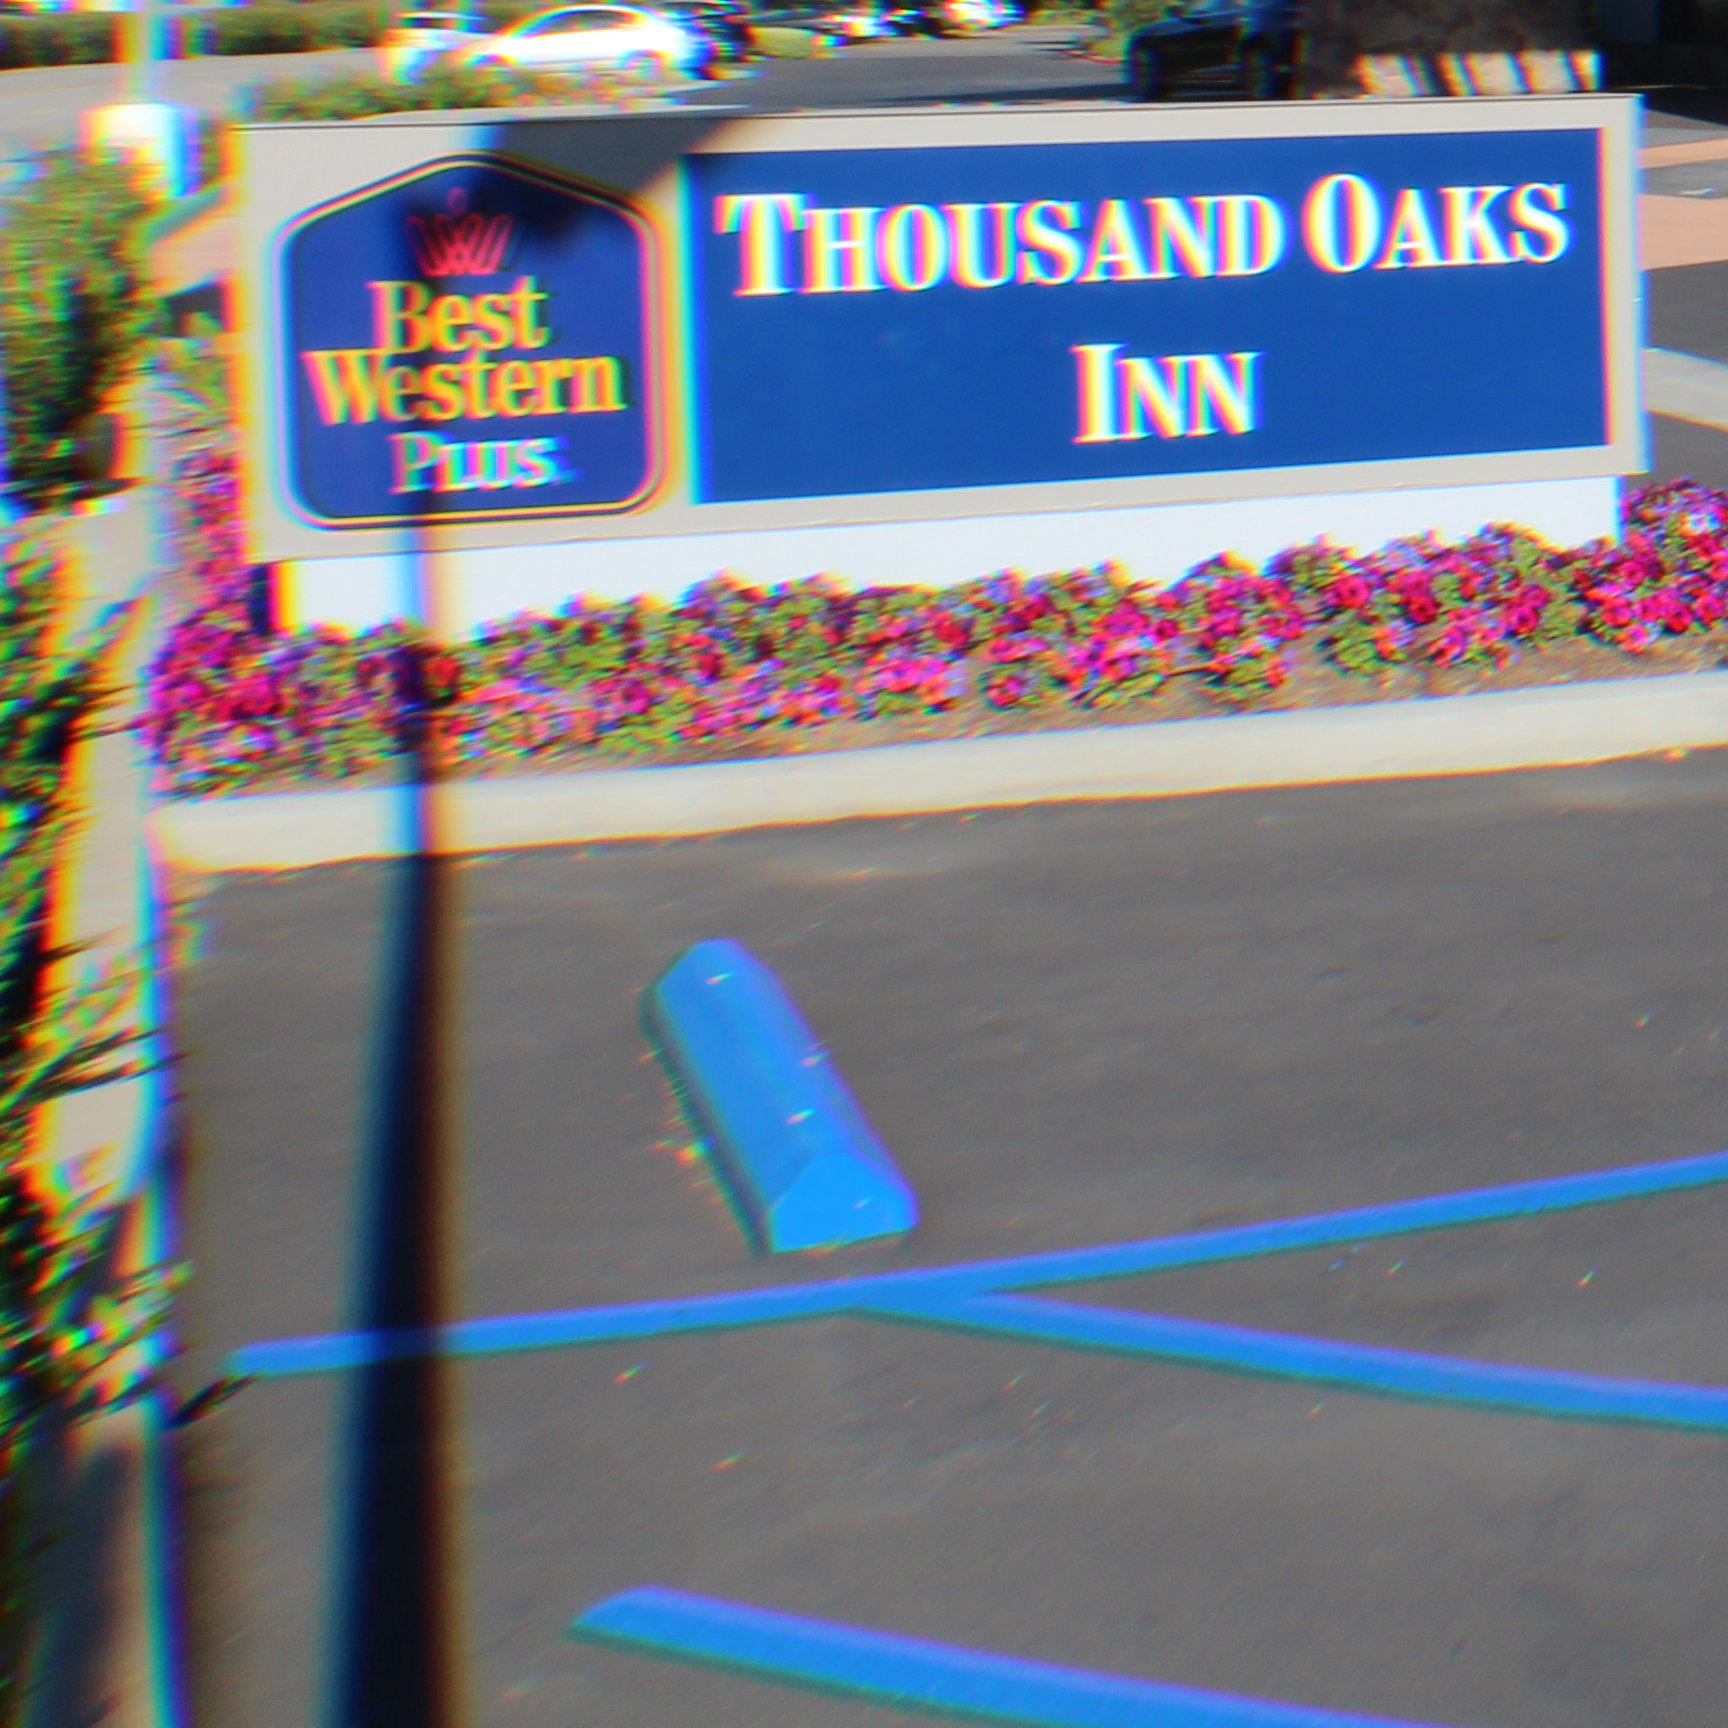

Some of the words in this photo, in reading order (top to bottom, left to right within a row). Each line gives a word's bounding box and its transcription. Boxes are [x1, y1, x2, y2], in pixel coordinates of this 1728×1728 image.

[714, 193, 1286, 297] THOUSAND
[1301, 173, 1570, 273] OAKS
[366, 275, 552, 353] Best
[301, 347, 628, 425] Western
[1071, 343, 1263, 445] INN
